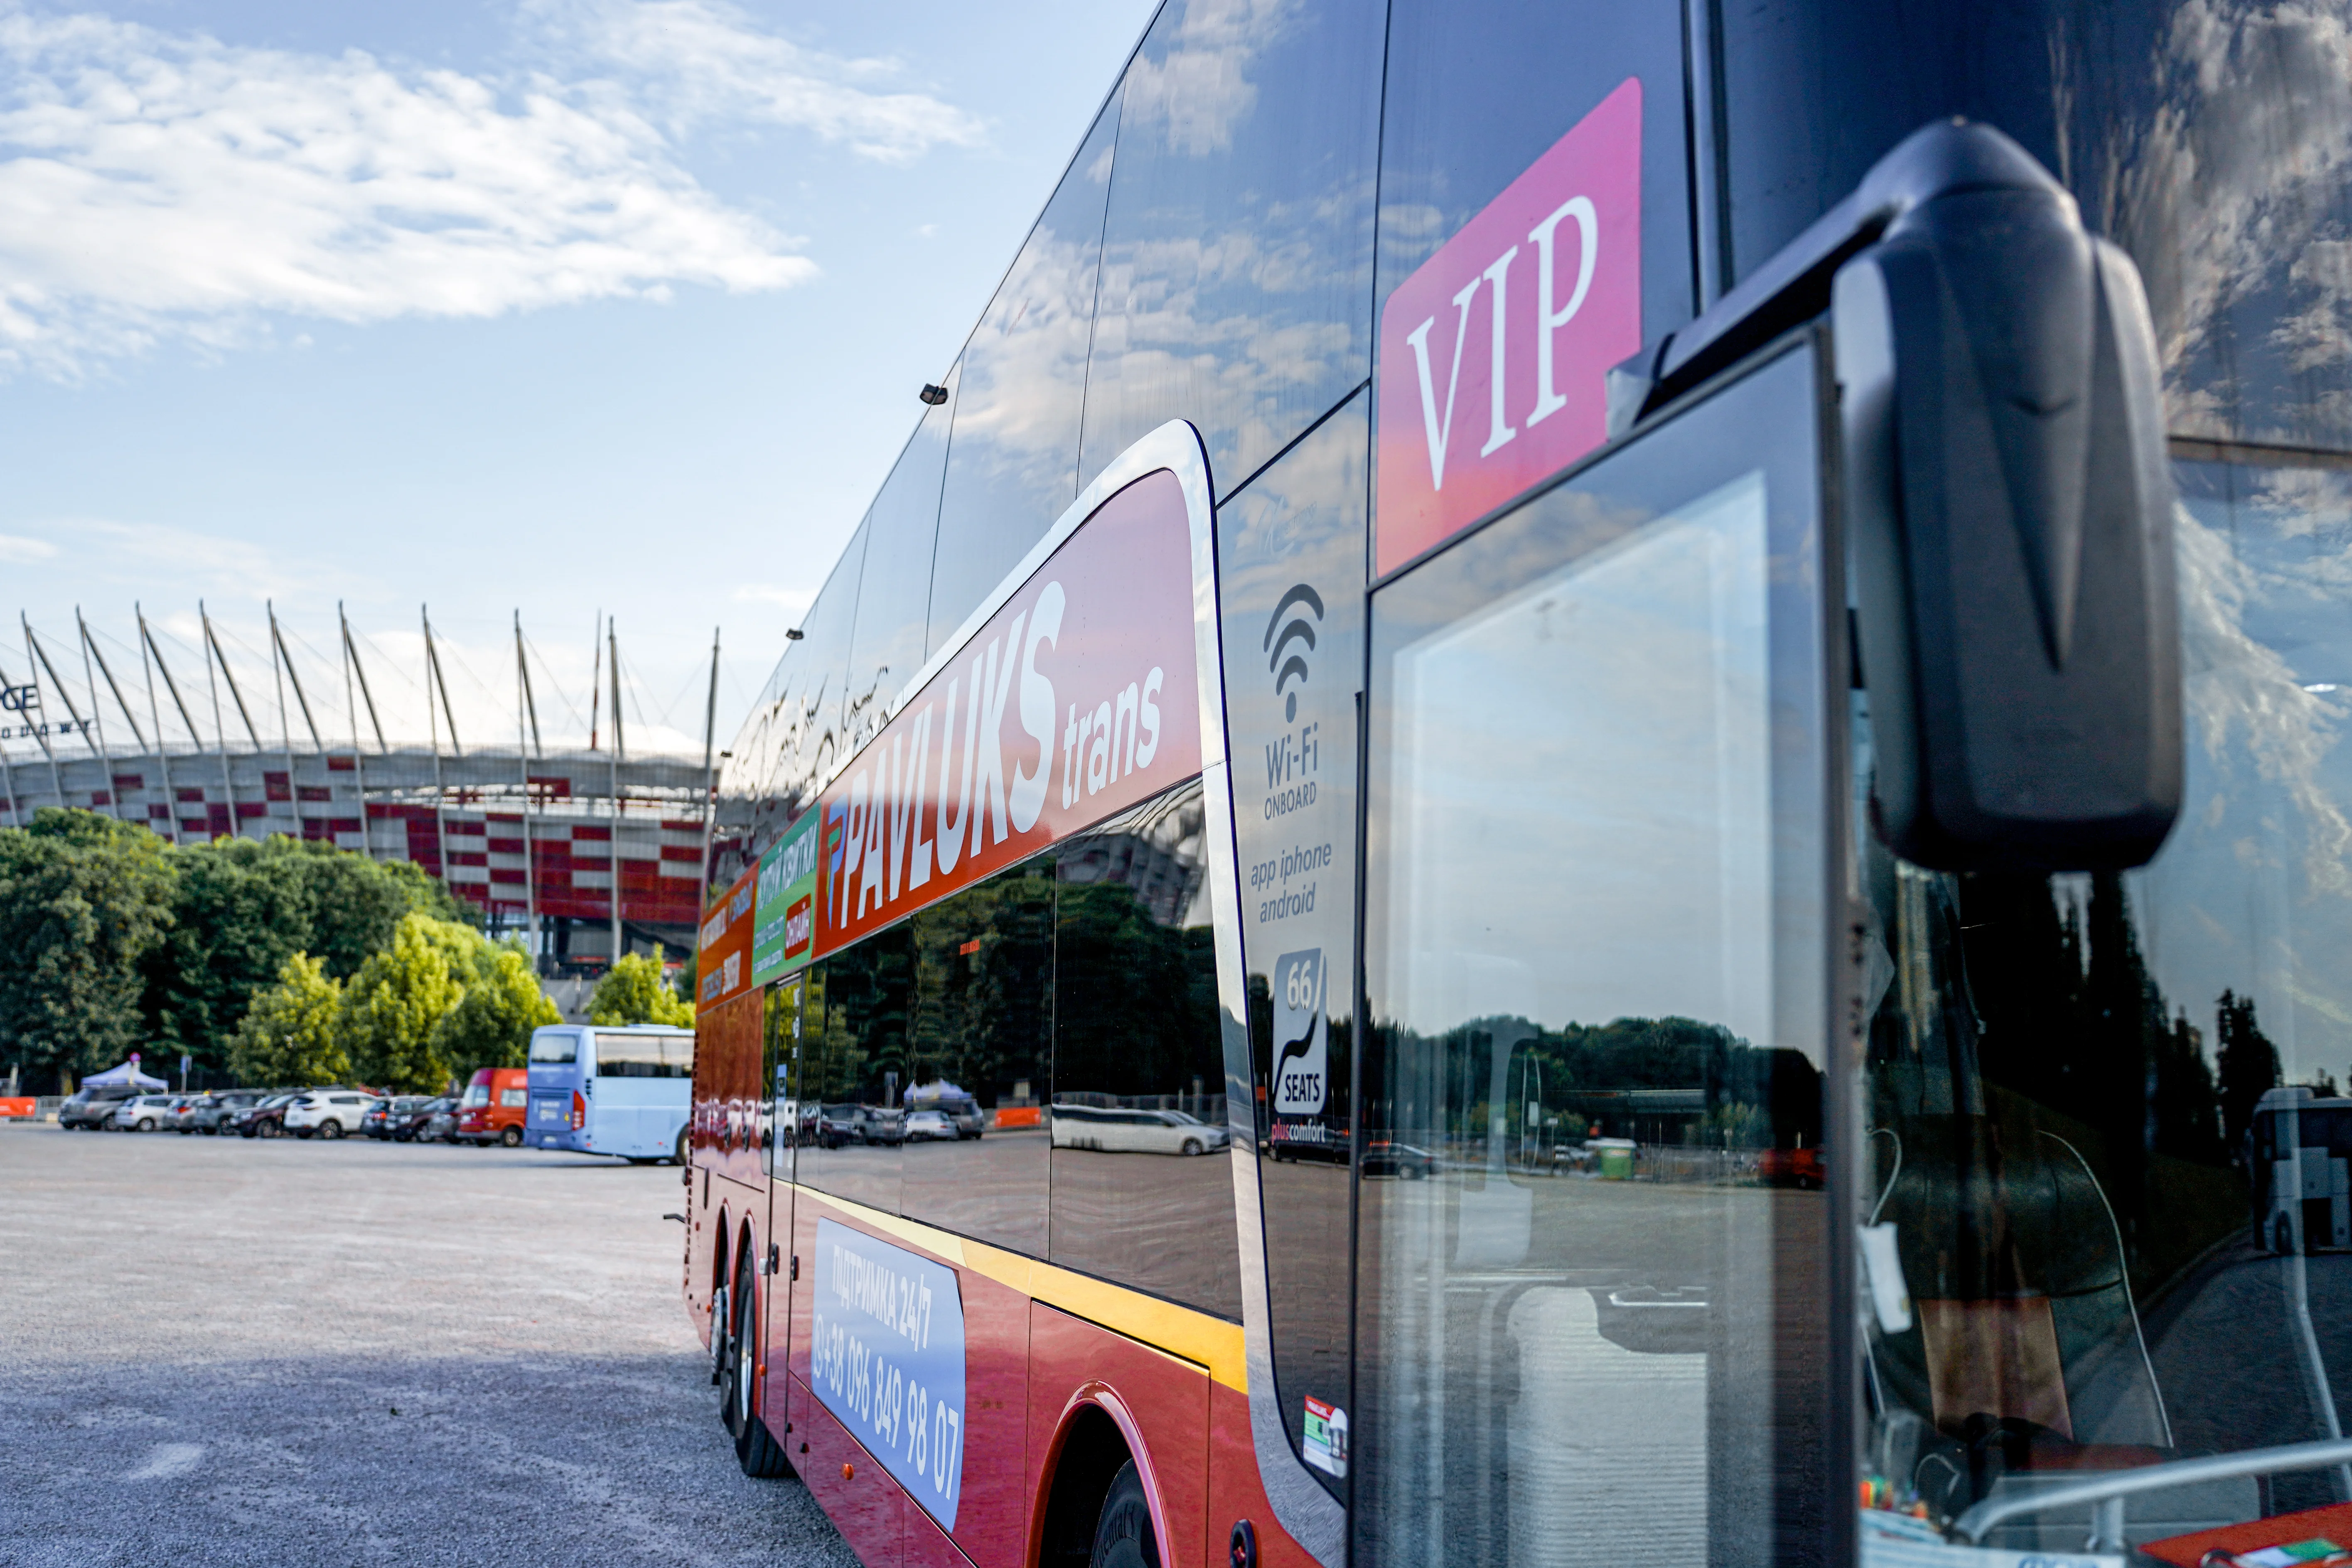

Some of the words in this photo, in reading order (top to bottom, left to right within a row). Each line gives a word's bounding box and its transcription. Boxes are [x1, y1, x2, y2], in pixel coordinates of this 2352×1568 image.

[1406, 195, 1598, 491] VIP
[0, 684, 40, 710] GE
[841, 580, 1066, 929] PAVLUKS
[1062, 666, 1164, 810] trans
[1266, 722, 1318, 789] Wi-Fi
[1264, 781, 1317, 820] ONBOARD
[1251, 857, 1276, 892] app
[1280, 843, 1332, 885] iphone
[1260, 882, 1316, 923] android
[1287, 959, 1312, 1010] 66
[1285, 1073, 1320, 1102] SEATS
[833, 1244, 897, 1331] ПІДТРИМКА
[900, 1273, 931, 1352] 24/7
[824, 1322, 844, 1398] +38
[847, 1335, 870, 1422] 096
[874, 1355, 902, 1449] 849
[907, 1379, 928, 1476] 98
[934, 1399, 959, 1500] 07
